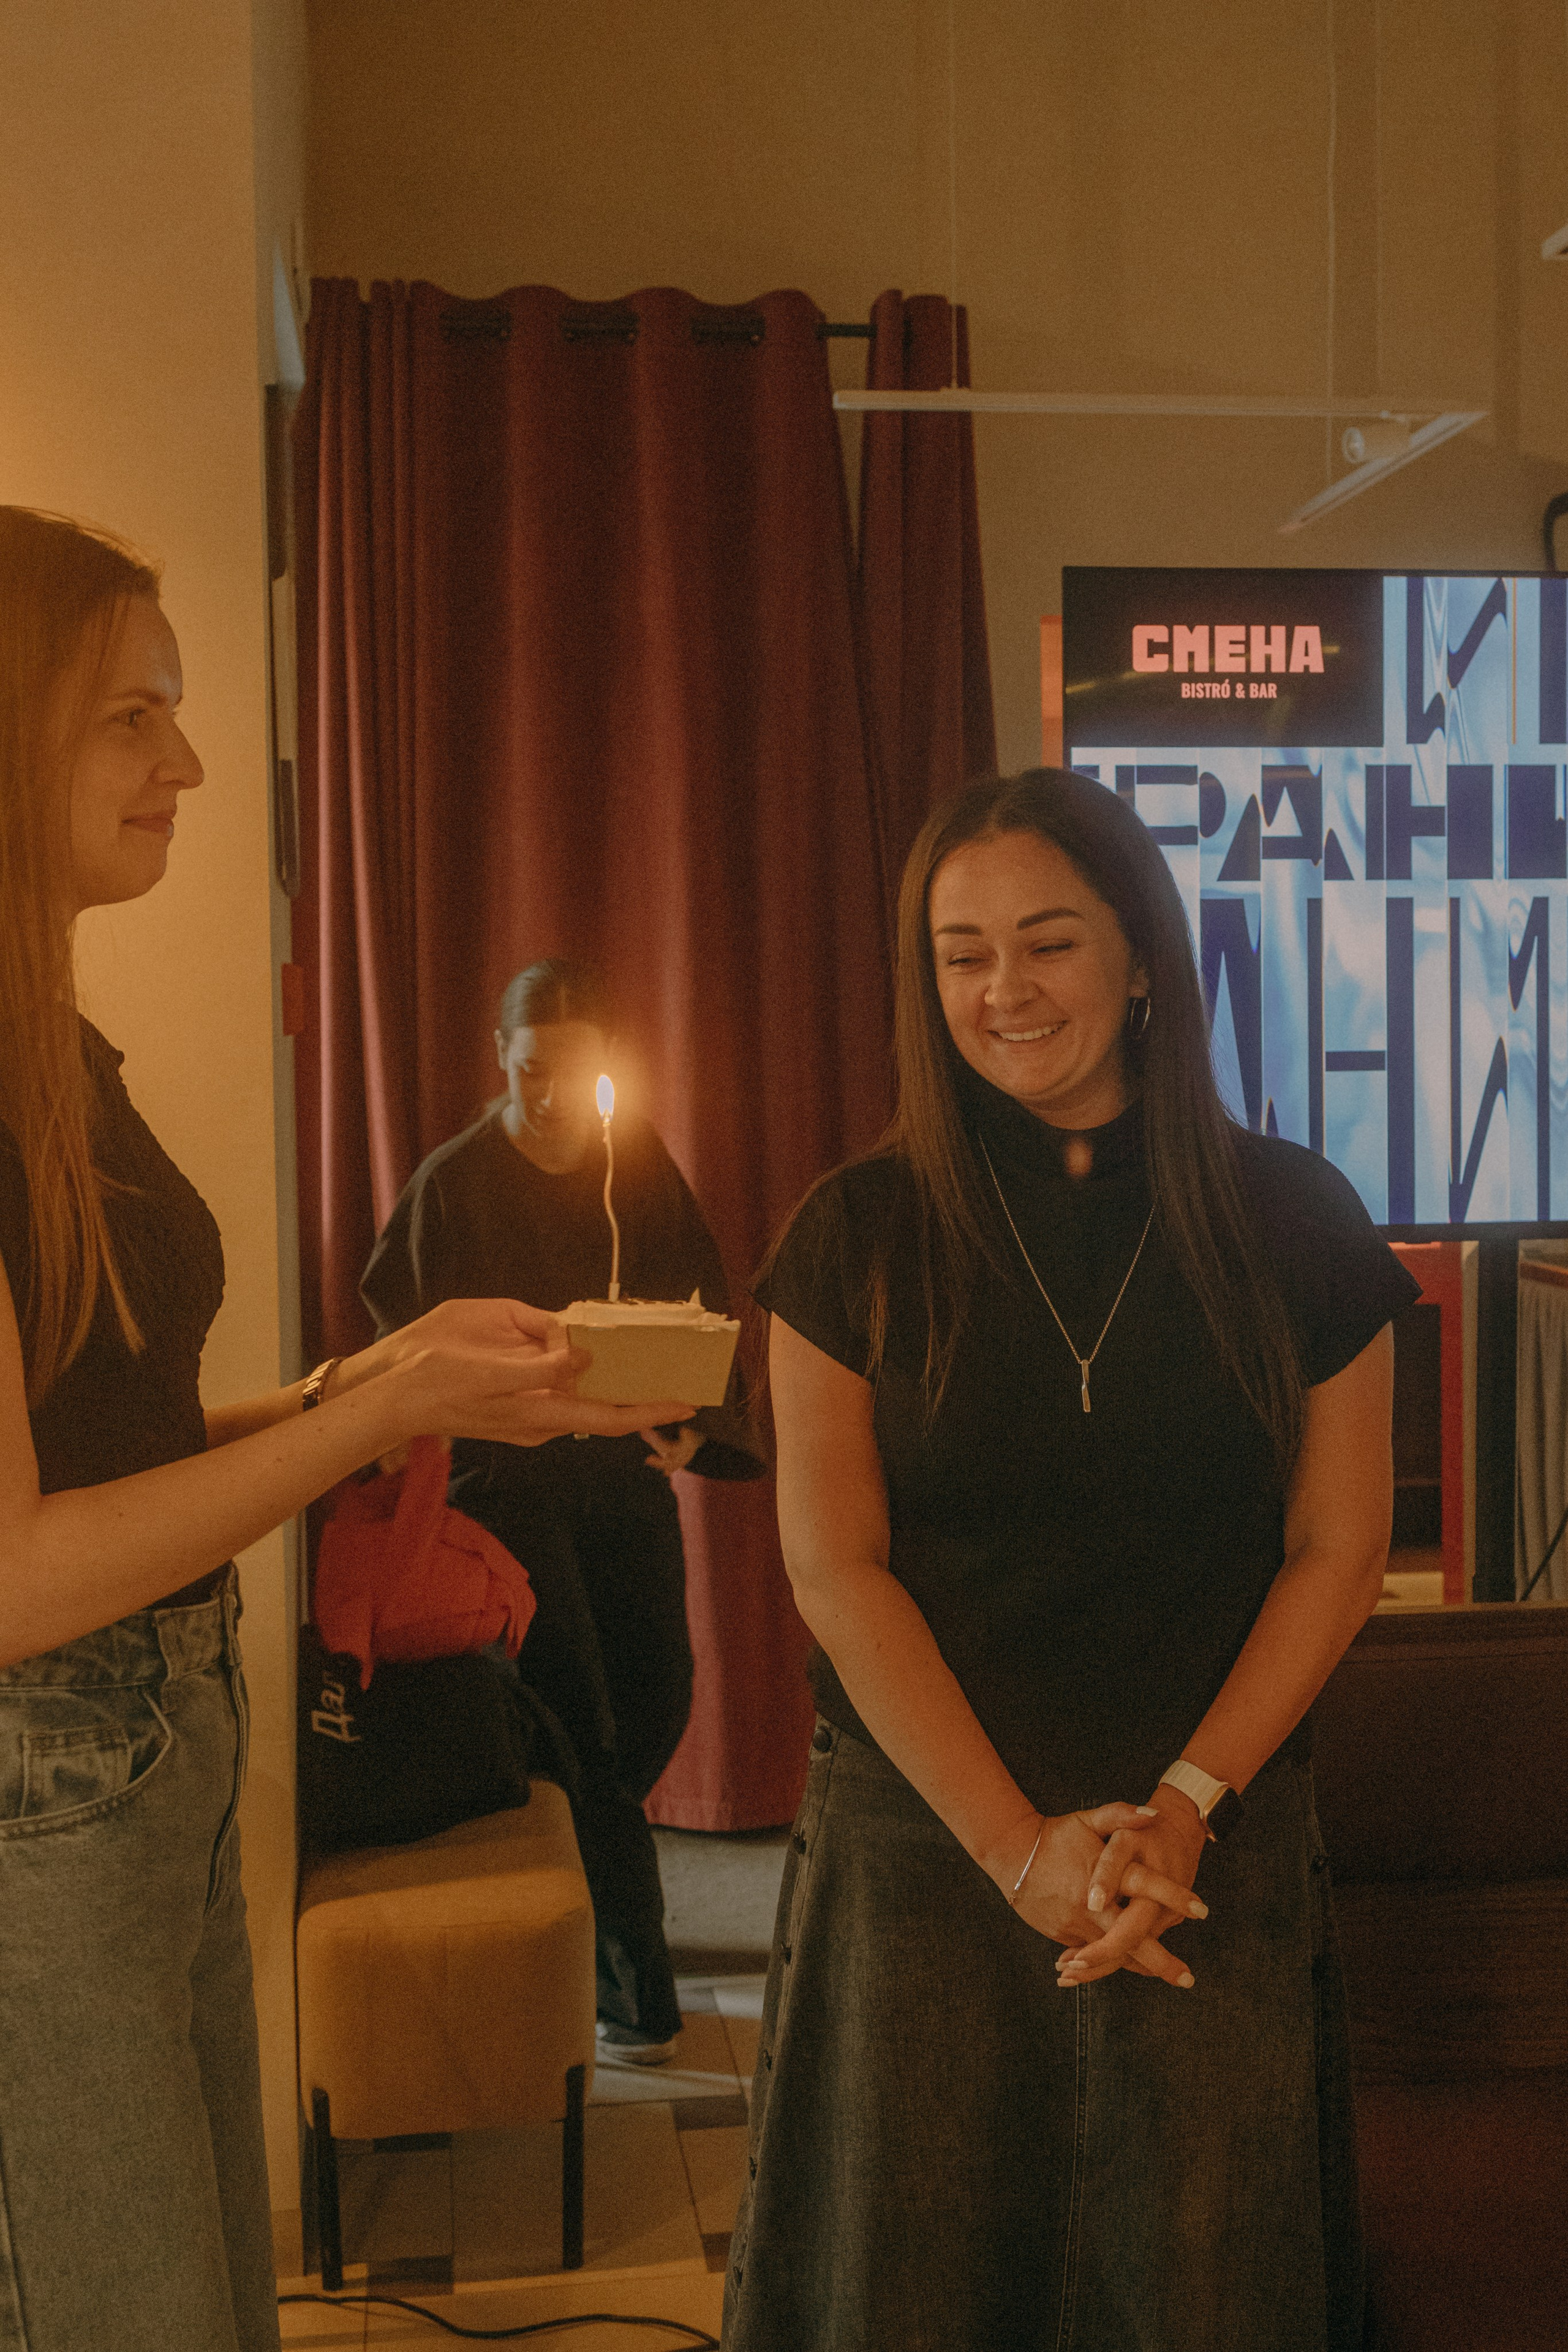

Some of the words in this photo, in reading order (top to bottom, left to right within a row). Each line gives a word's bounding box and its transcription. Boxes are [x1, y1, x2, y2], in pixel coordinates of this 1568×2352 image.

[1132, 625, 1324, 673] СМЕНА
[1181, 679, 1231, 699] BISTRÓ
[1235, 683, 1245, 699] &
[1250, 683, 1277, 699] BAR
